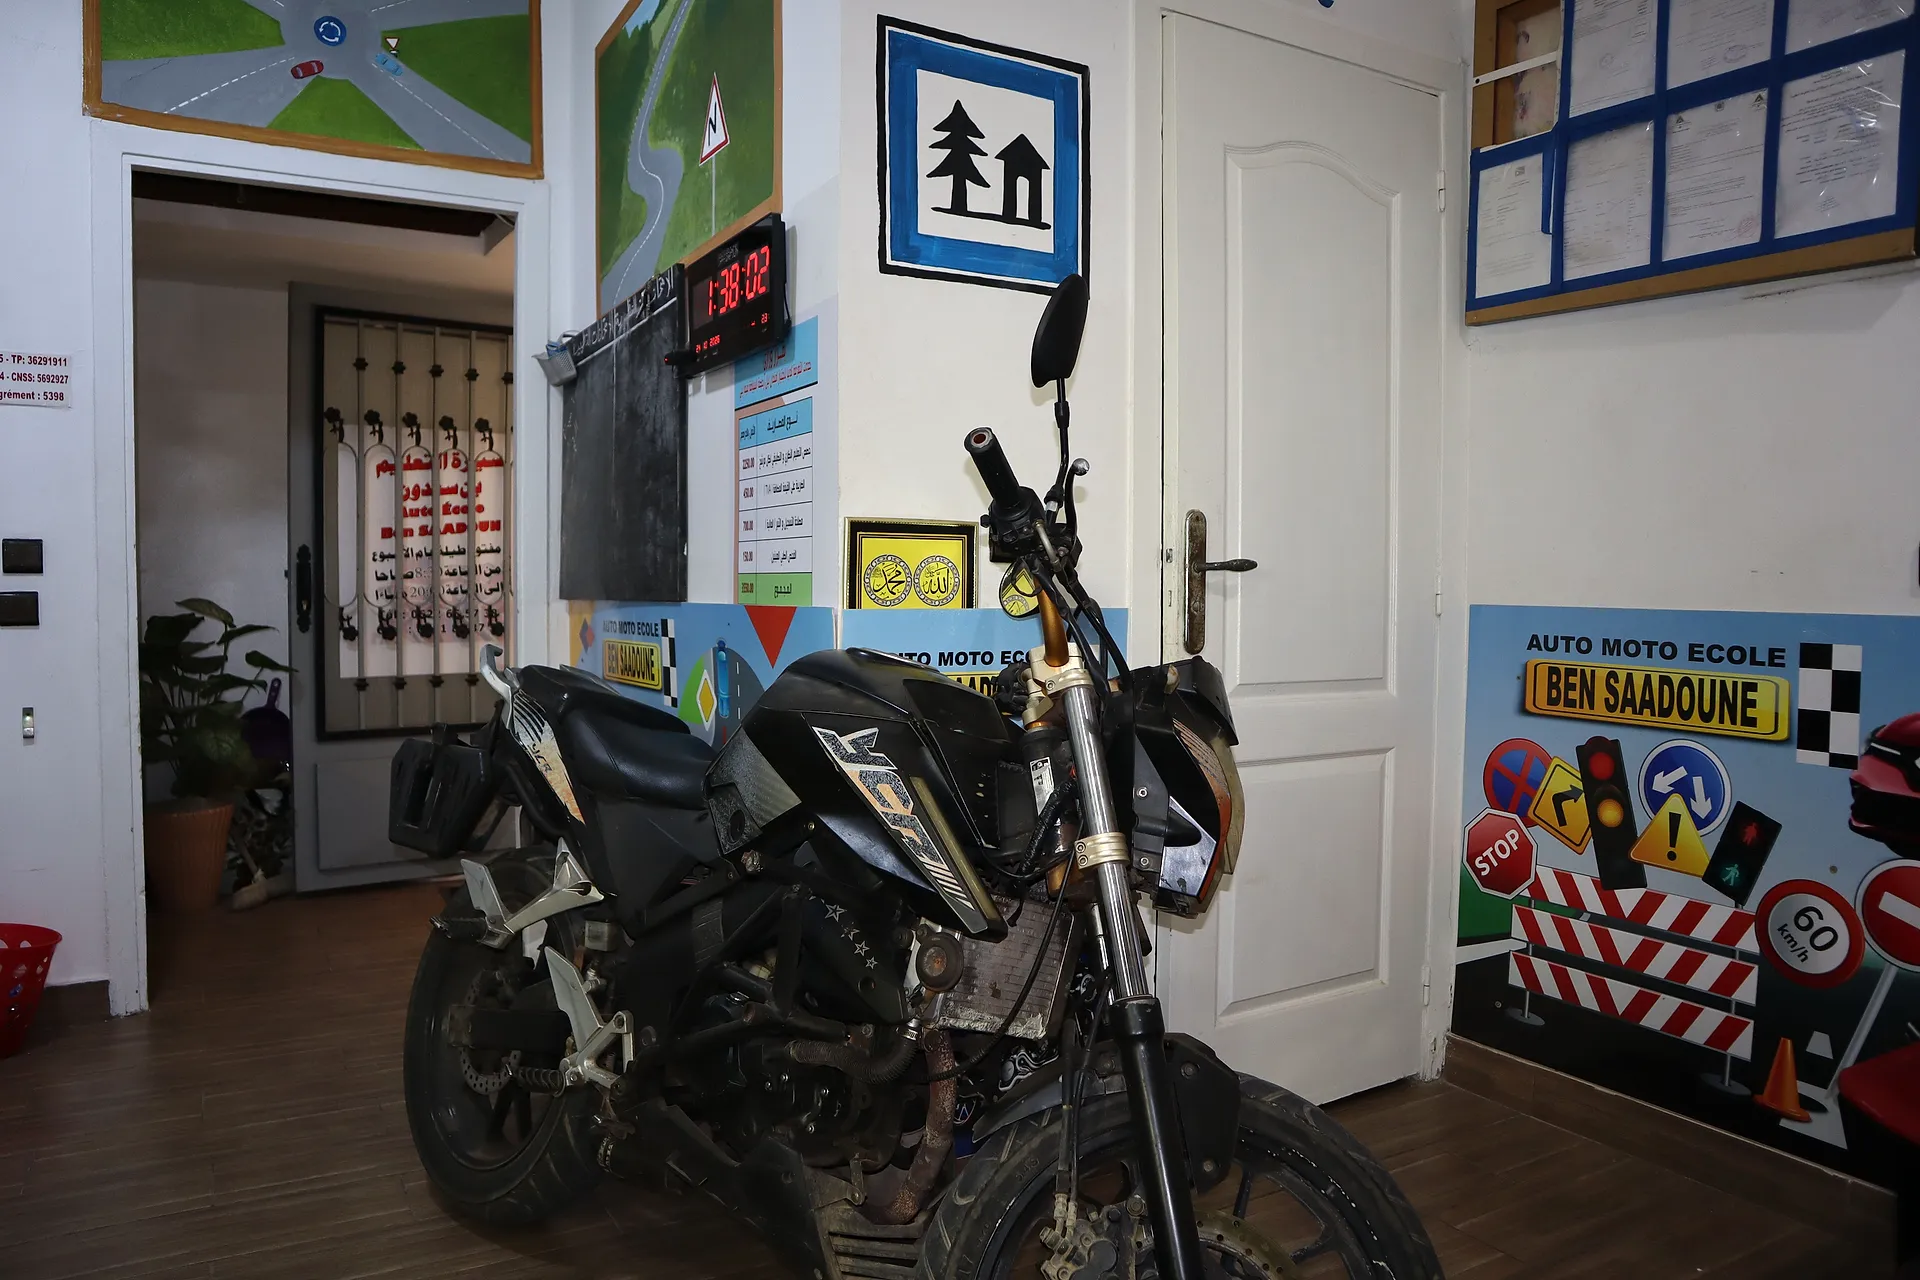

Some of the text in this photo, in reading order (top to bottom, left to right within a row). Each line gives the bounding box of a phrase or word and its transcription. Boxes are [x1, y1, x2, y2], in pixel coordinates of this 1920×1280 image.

[11, 354, 25, 364] TP:
[28, 355, 67, 367] 36291911
[11, 372, 35, 382] CNSS:
[37, 374, 69, 384] 5692927
[43, 391, 65, 401] 5398
[618, 620, 636, 635] MOTO
[636, 621, 659, 637] ECOLE
[620, 644, 655, 682] SAADOUNE
[938, 651, 994, 667] MOTO
[1526, 633, 1786, 668] AUTO MOTO ECOLE
[1546, 665, 1759, 728] BEN SAADOUNE
[1474, 829, 1520, 877] STOP
[1777, 923, 1809, 963] km/h
[1793, 906, 1839, 952] 60
